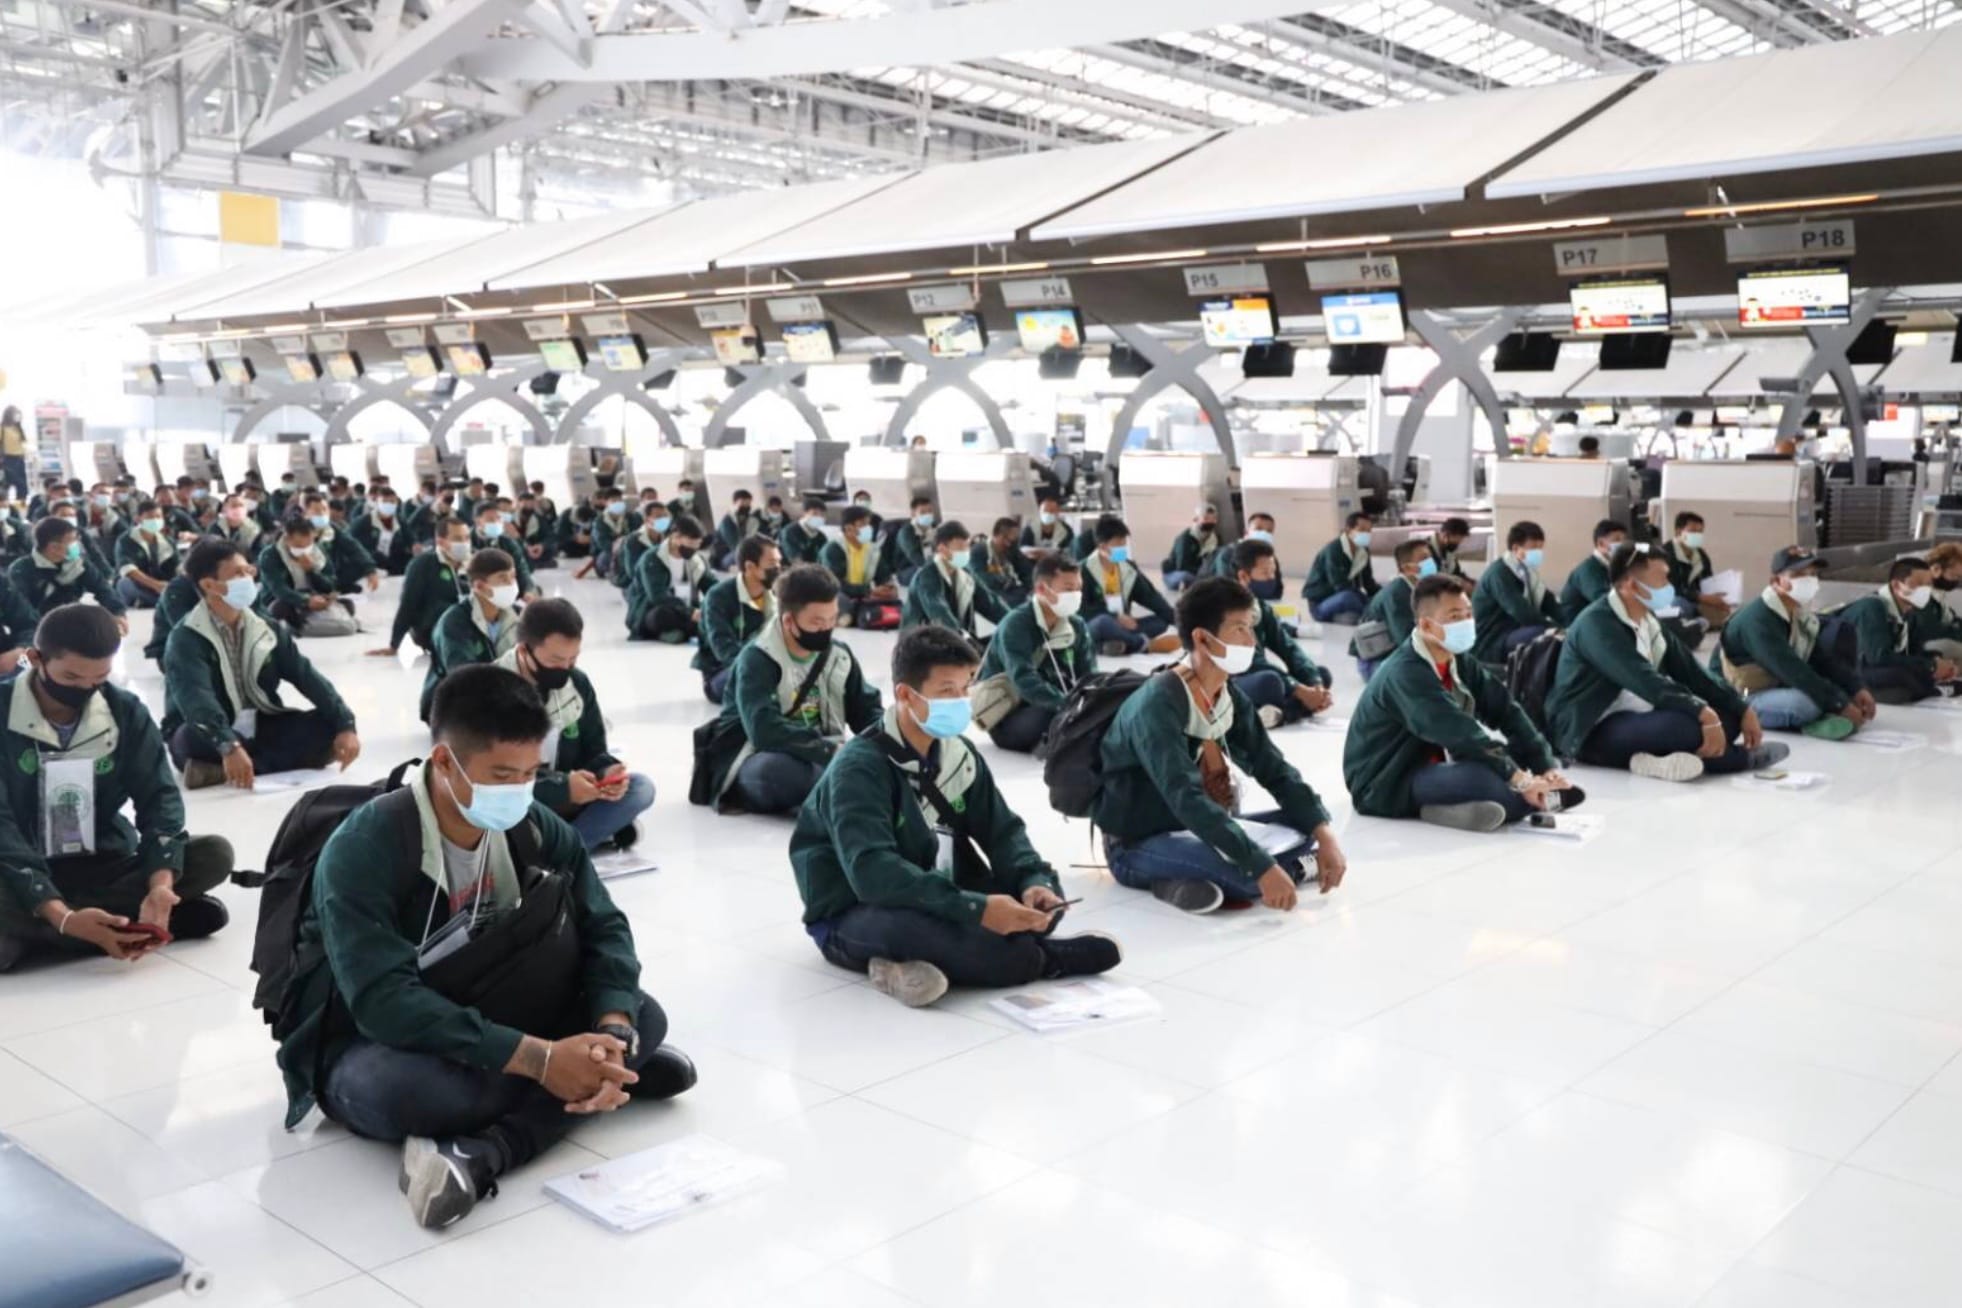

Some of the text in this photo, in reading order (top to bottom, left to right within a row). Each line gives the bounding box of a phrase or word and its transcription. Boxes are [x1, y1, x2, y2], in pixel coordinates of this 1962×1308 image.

[1801, 230, 1846, 248] P18
[1563, 249, 1598, 265] P17
[1360, 264, 1392, 279] P16
[1190, 273, 1219, 287] P15
